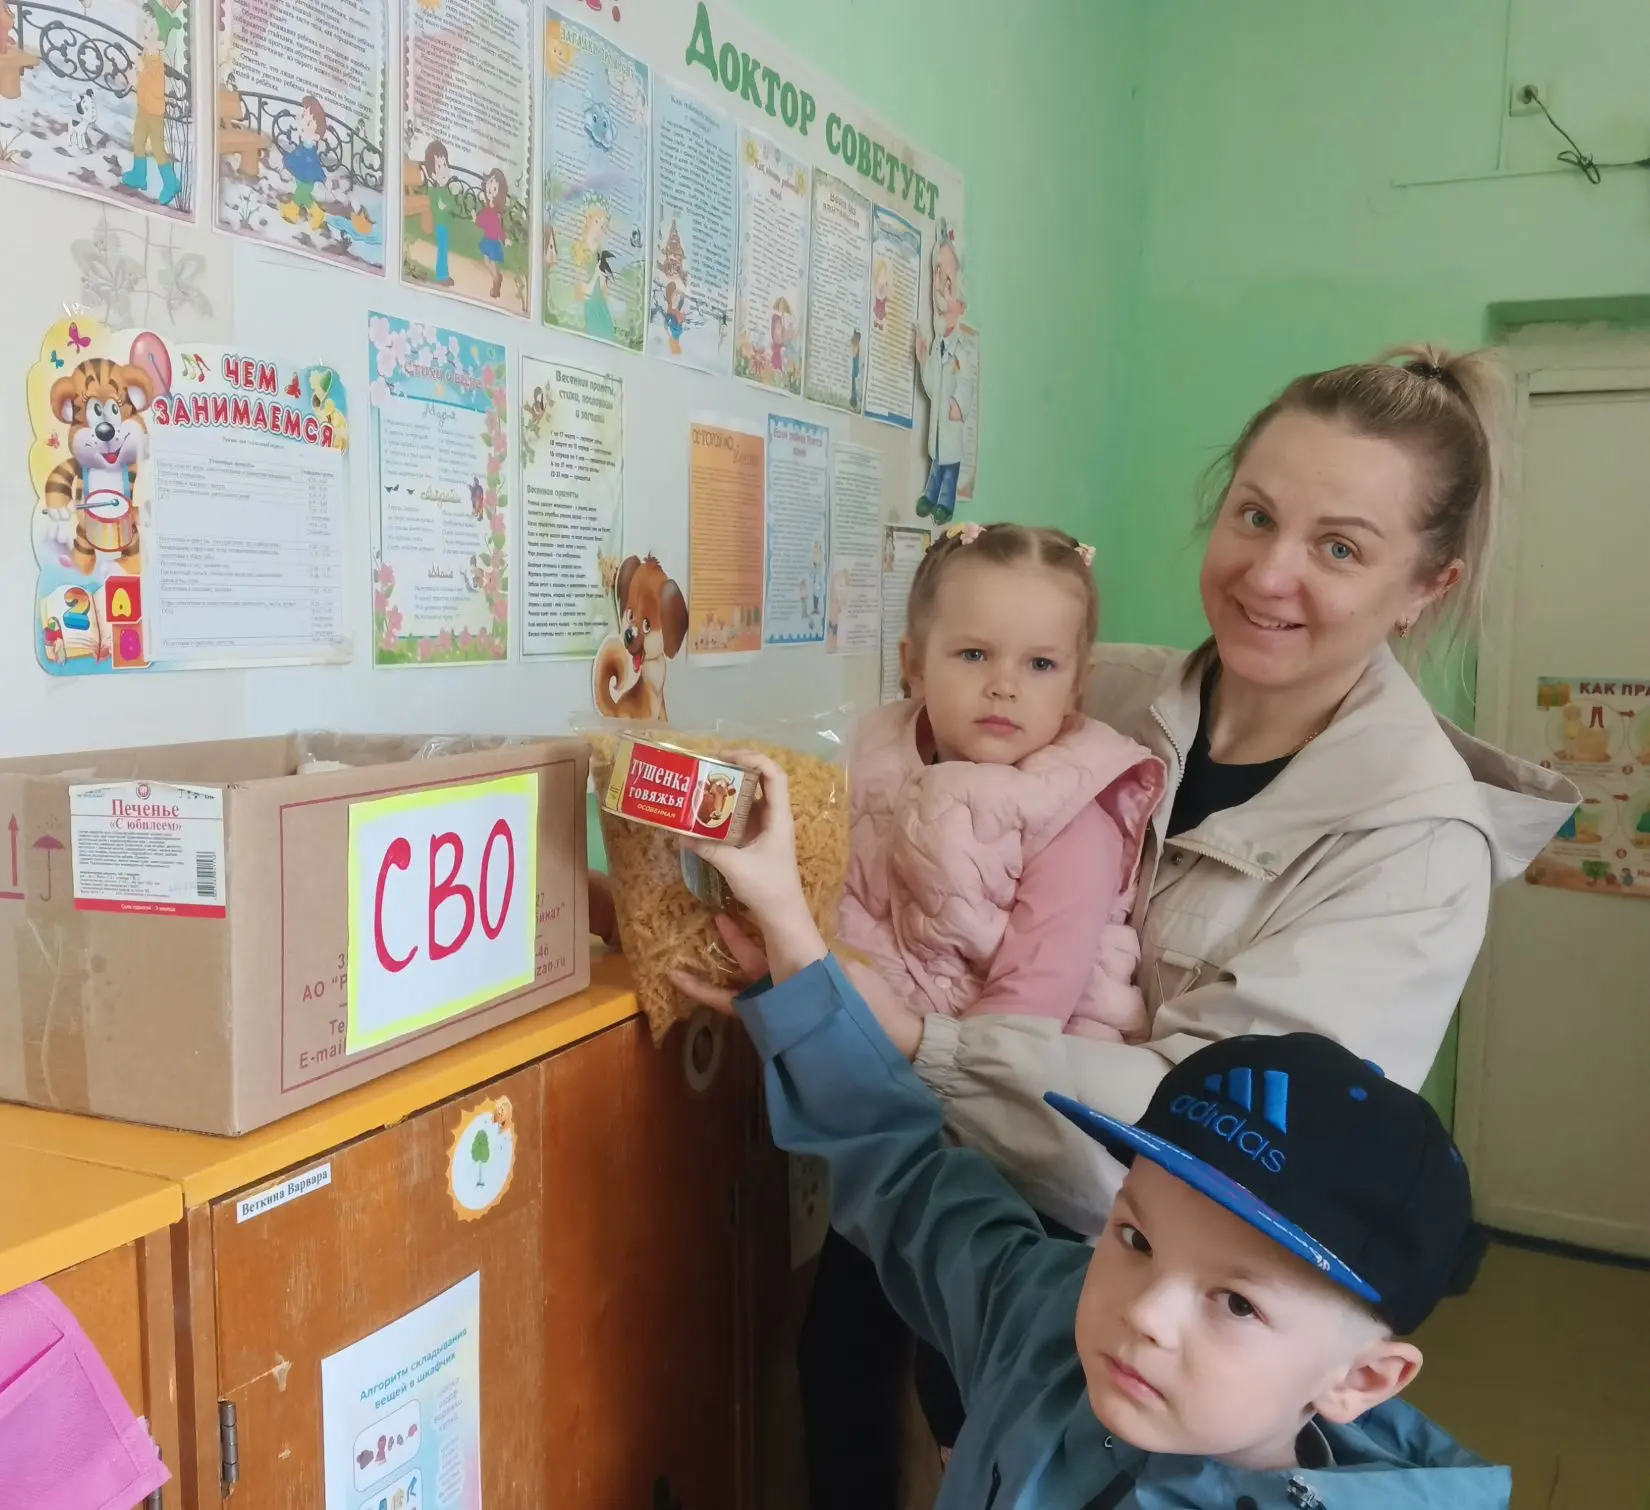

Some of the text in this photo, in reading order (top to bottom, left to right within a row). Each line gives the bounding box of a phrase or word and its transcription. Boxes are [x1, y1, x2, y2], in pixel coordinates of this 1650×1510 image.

[223, 355, 278, 394] ЧЕМ
[153, 397, 334, 449] ЗАНИМАЕМСЯ
[1580, 682, 1616, 695] КАК
[112, 799, 180, 817] Печенье
[629, 785, 685, 808] говяжья
[374, 818, 515, 973] СВО
[302, 981, 325, 1001] АО
[1170, 1094, 1287, 1173] adidas
[242, 1170, 328, 1216] Веткина Варвара
[359, 1327, 468, 1402] Алгоритм складывания
[375, 1352, 456, 1409] вещей в шкафчик
